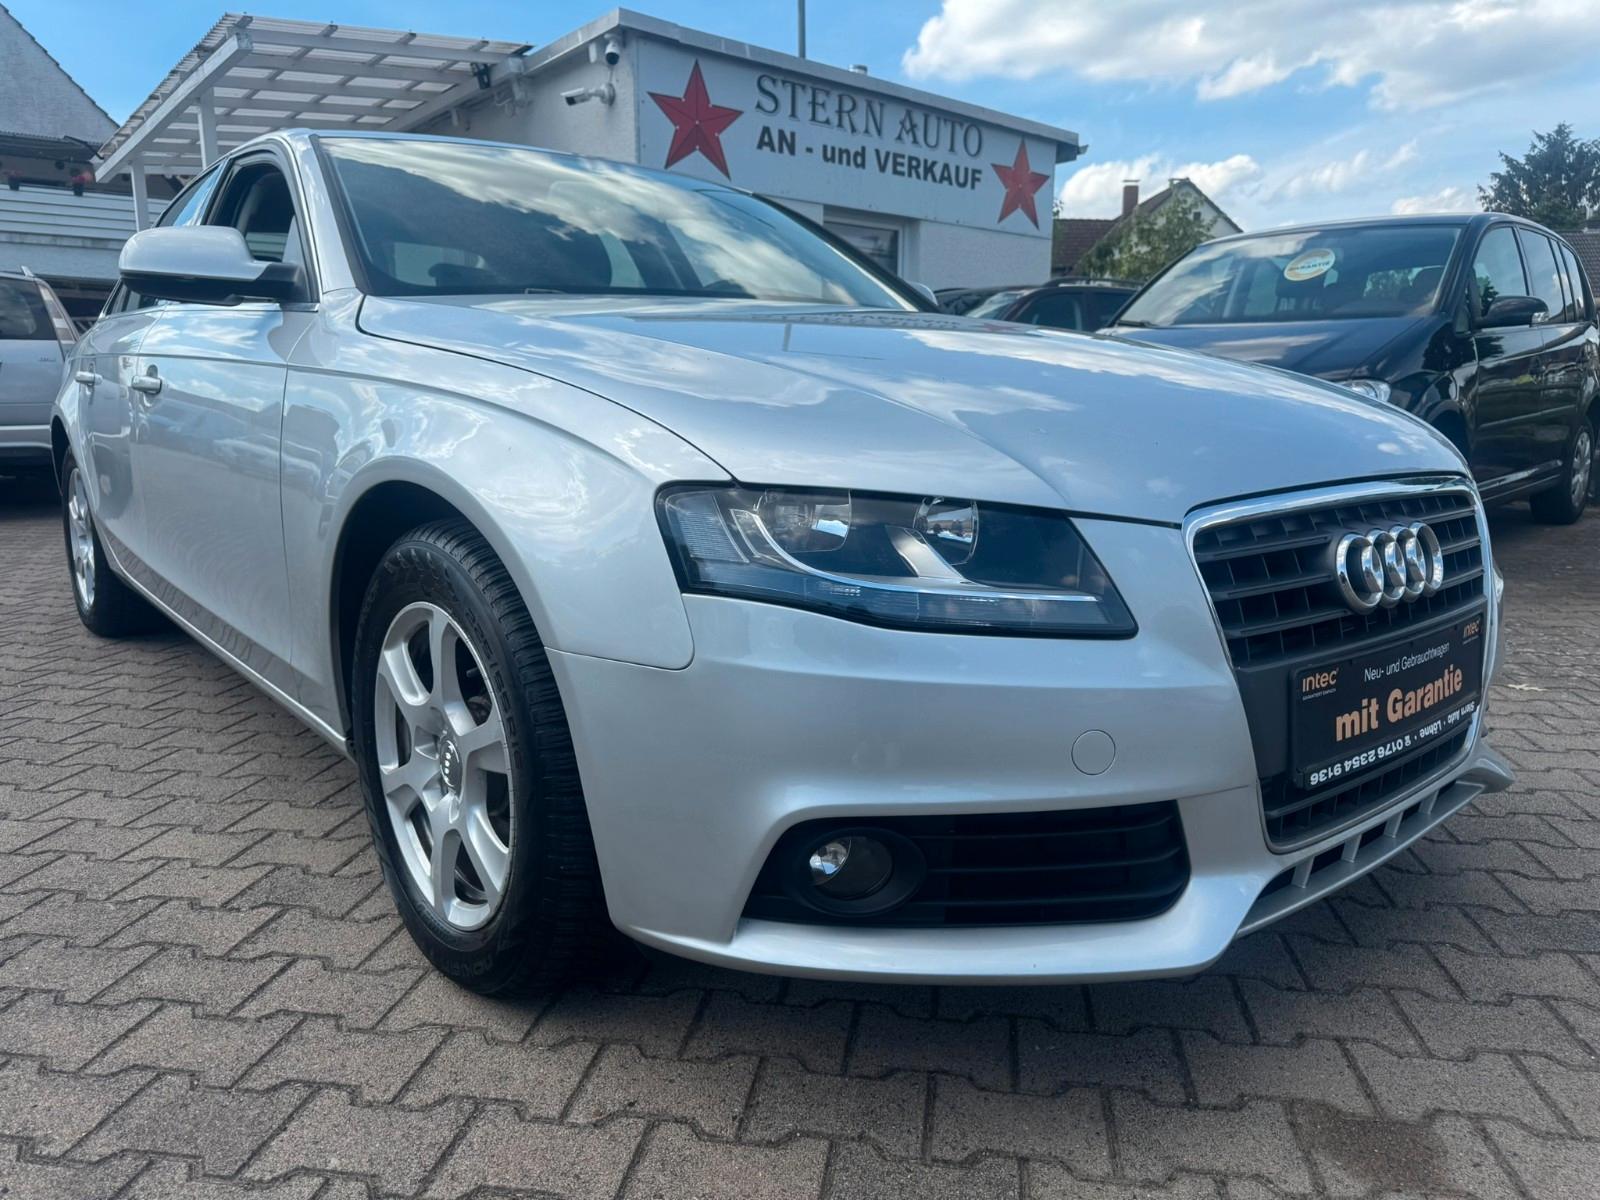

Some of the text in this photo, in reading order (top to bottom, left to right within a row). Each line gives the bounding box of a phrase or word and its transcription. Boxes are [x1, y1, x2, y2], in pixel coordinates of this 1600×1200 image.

[755, 73, 983, 157] STERN AUTO
[756, 125, 796, 156] AN
[822, 144, 866, 170] und
[874, 148, 983, 190] VERKAUF
[1364, 642, 1450, 682] Neu- und Gebrauchtwagen
[1302, 670, 1338, 693] intec
[1335, 664, 1463, 742] mit Garantie
[1447, 710, 1460, 724] Auto
[1419, 720, 1442, 738] Löhne
[1377, 738, 1404, 759] 0176
[1343, 749, 1376, 772] 2354
[1310, 763, 1342, 785] 9136
